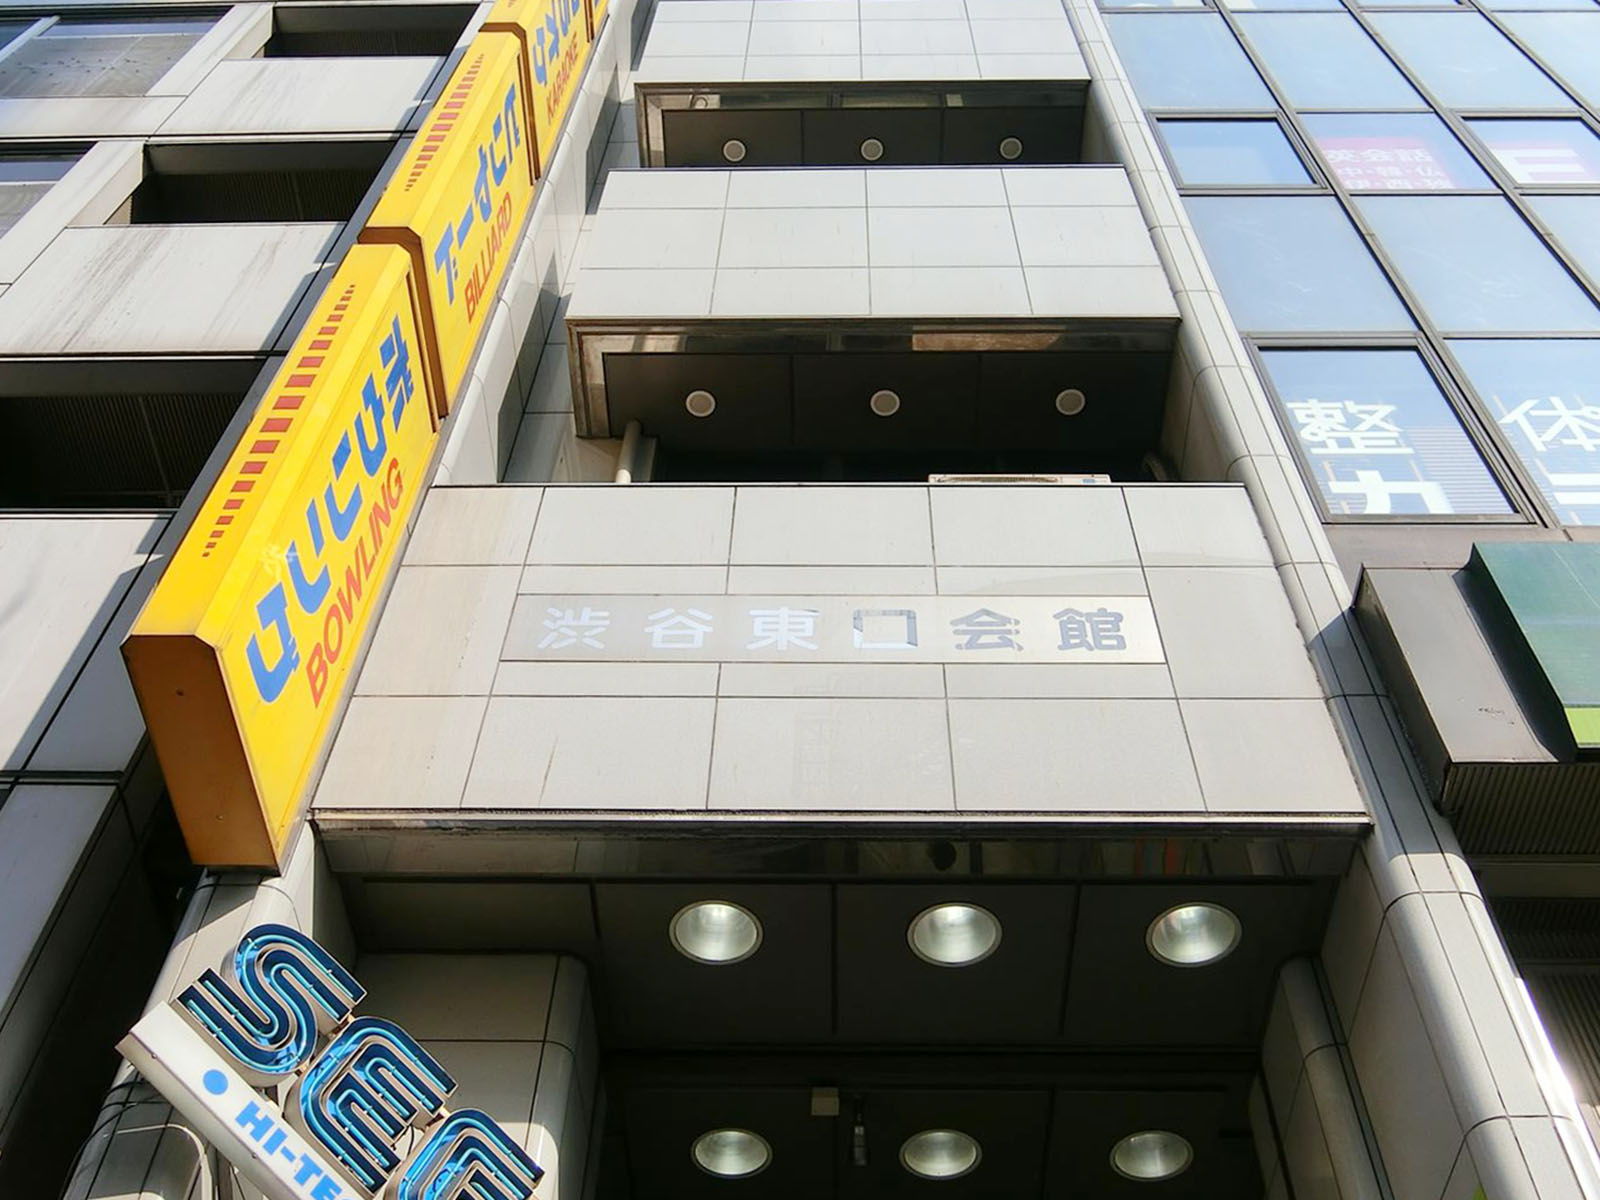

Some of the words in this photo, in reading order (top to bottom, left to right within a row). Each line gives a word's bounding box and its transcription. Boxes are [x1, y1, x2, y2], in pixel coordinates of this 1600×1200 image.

[546, 32, 579, 124] KARAOKE
[434, 83, 524, 306] ビリヤード
[464, 191, 513, 325] BILLIARD
[246, 314, 414, 703] ボウリング
[305, 457, 404, 708] BOWLING
[536, 606, 1126, 653] 渋谷東口会館
[235, 1100, 354, 1200] HI-TE
